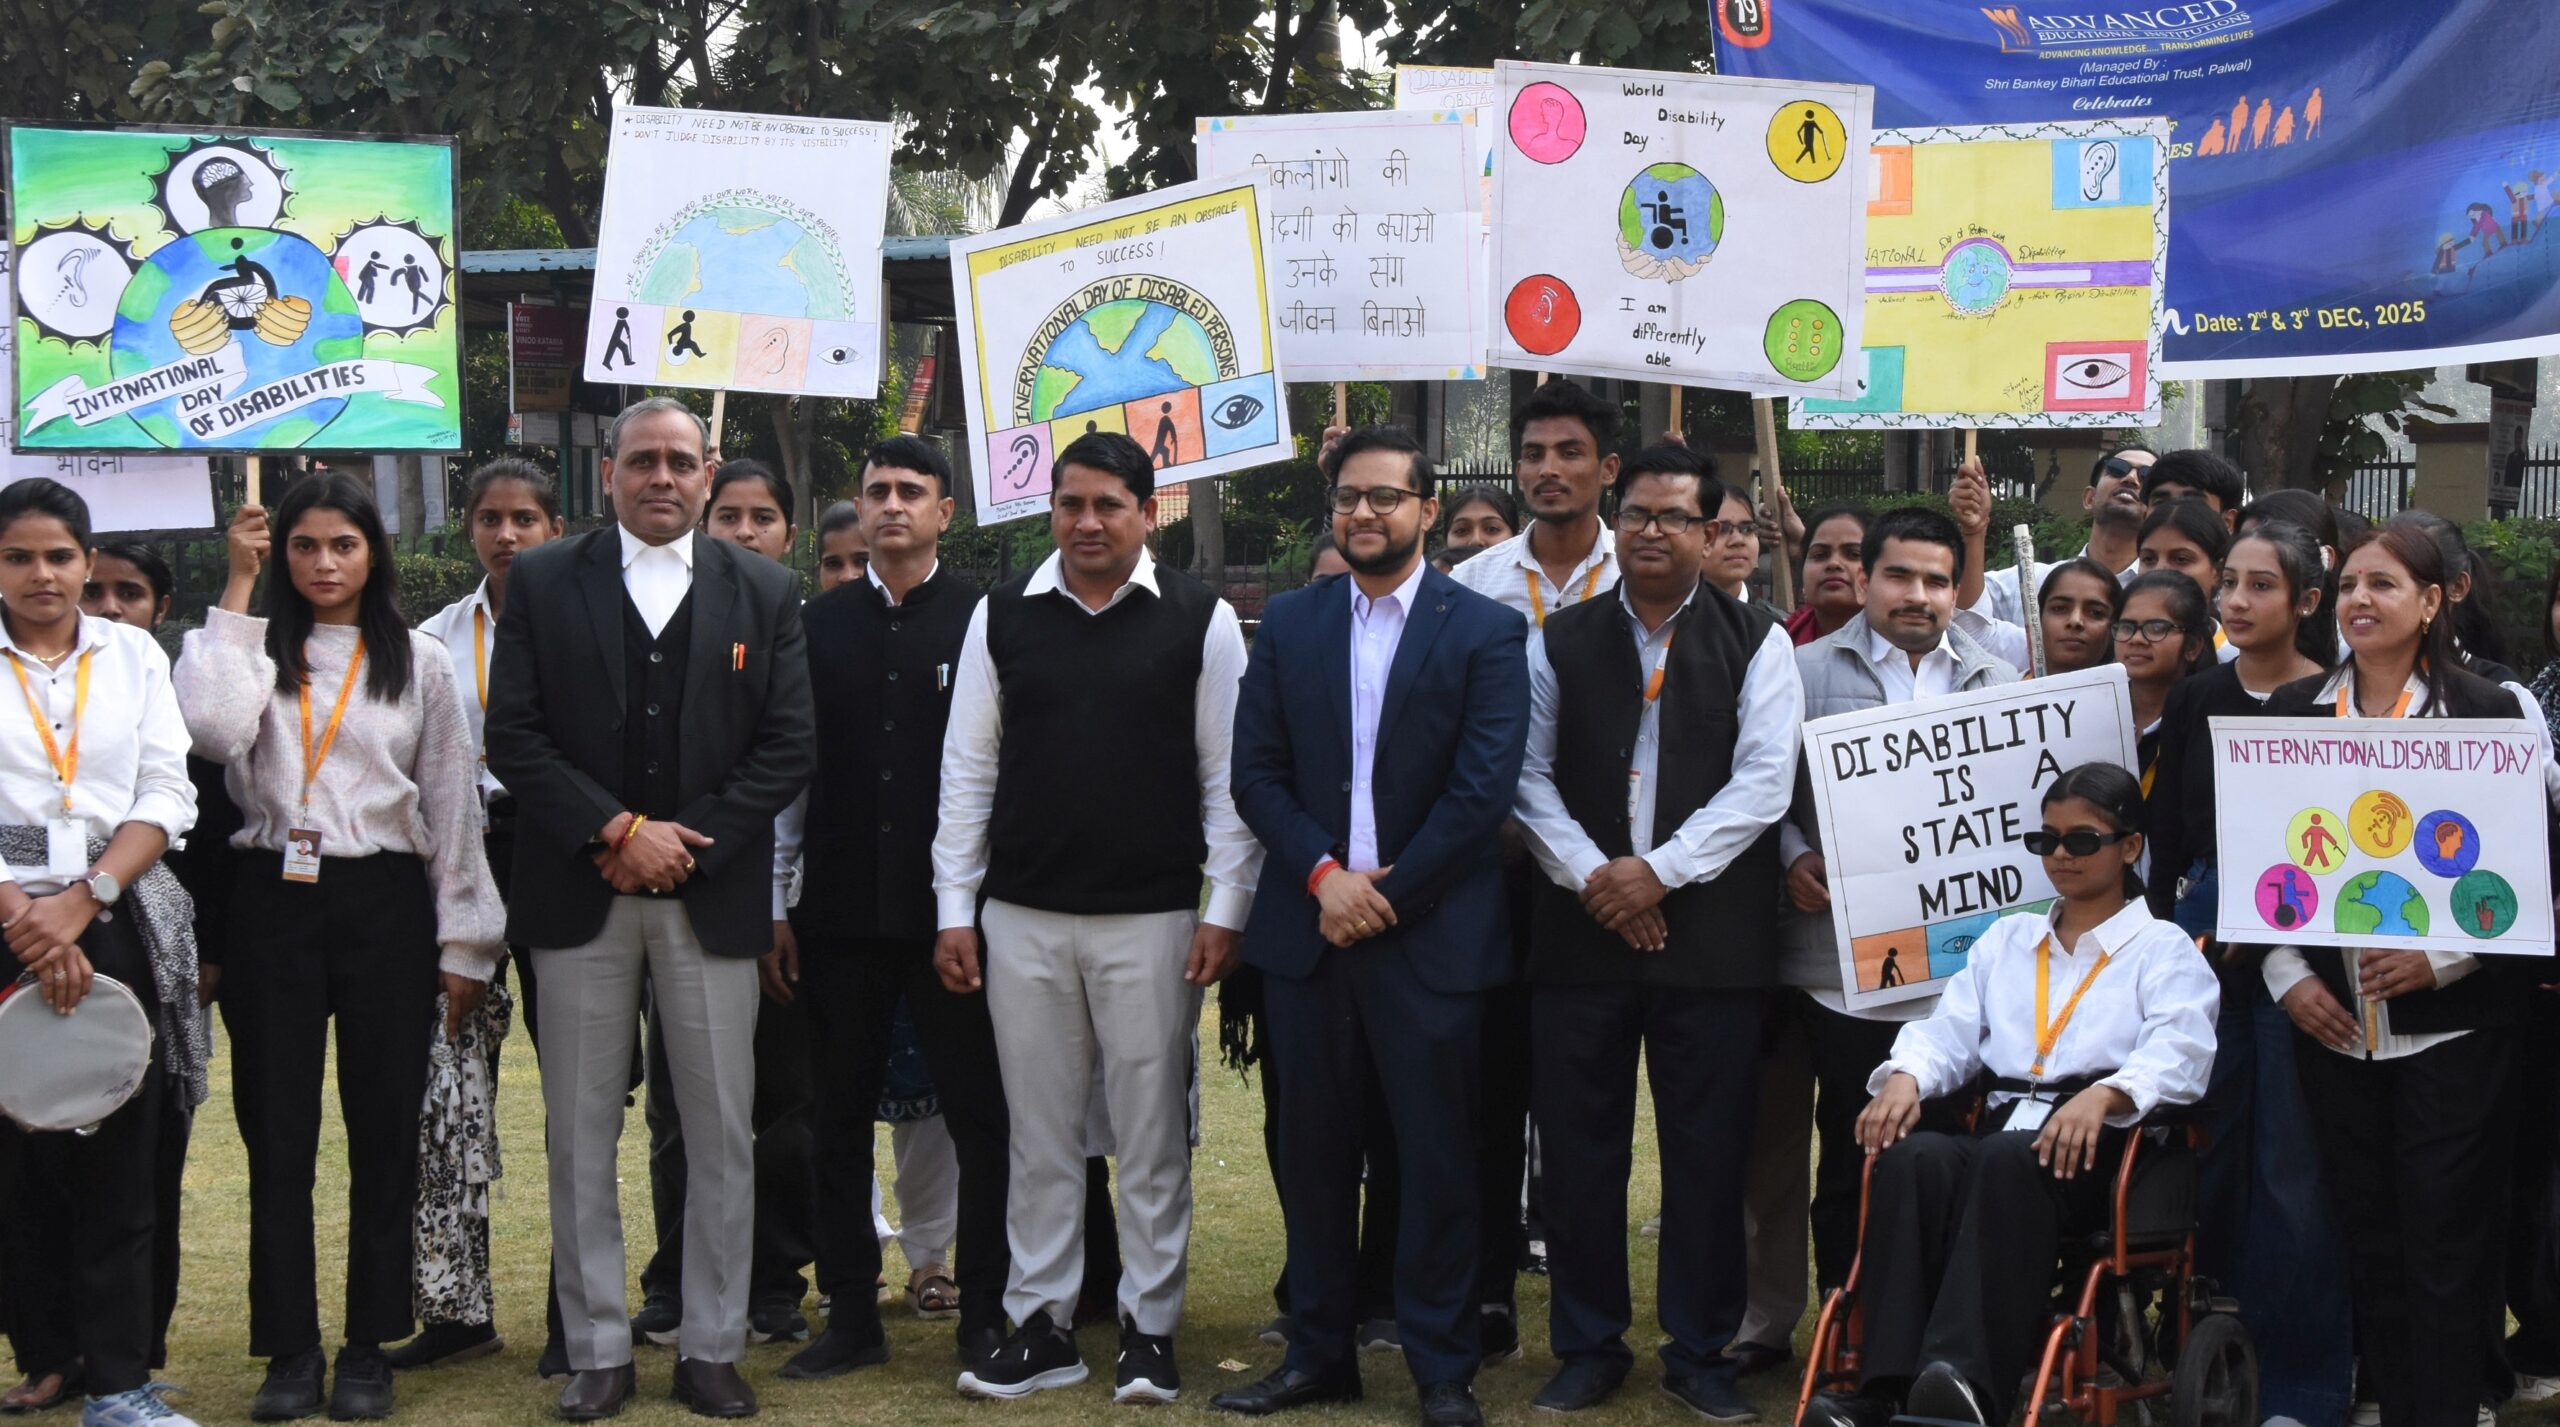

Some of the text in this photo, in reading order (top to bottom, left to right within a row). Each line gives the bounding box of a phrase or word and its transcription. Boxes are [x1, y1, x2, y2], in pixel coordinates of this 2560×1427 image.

[1735, 0, 1757, 23] 19
[2029, 0, 2239, 30] ADVANCED
[2037, 12, 2251, 41] EDUCATIONAL INSTITUTIONS
[2039, 48, 2090, 59] ADVANCING
[2230, 29, 2254, 42] LIVES
[1985, 58, 2251, 91] Shri Bankey Bihari Educational Trust, Palwal)
[2080, 60, 2140, 75] (Managed
[2143, 59, 2160, 73] By
[1623, 83, 1664, 97] World
[2072, 95, 2153, 111] Celebrates
[635, 114, 682, 125] DISABILITY
[691, 118, 725, 130] NEED
[751, 121, 762, 132] BE
[764, 122, 780, 132] AN
[821, 126, 830, 136] TO
[1658, 108, 1725, 132] Disability
[634, 130, 659, 139] DON'T
[665, 131, 698, 143] JUDGE
[702, 134, 760, 146] DISABILITY
[764, 137, 776, 146] BY
[1624, 131, 1649, 153] Day
[1382, 149, 1410, 187] की
[999, 200, 1239, 270] DISABILITY NEED NOT BE AN OBSTACLE
[1332, 205, 1359, 243] को
[1377, 207, 1437, 244] बचाओ
[1059, 259, 1075, 274] TO
[1285, 249, 1406, 288] उनके संग
[1279, 296, 1426, 338] जीवन बिताओ
[1619, 297, 1667, 314] I am
[2195, 313, 2243, 333] Date:
[2271, 312, 2287, 331] &
[2318, 306, 2370, 330] DEC,
[2375, 301, 2426, 326] 2025
[1082, 283, 1110, 309] DAY
[1111, 278, 1133, 300] OF
[1137, 277, 1209, 322] DISABLED
[1204, 314, 1237, 378] PERSONS
[1632, 322, 1706, 355] differently
[1645, 351, 1671, 367] able
[67, 356, 225, 421] INTRNATIONAL
[181, 383, 223, 413] DAY
[189, 364, 366, 437] OF DISABILITIES
[2490, 740, 2535, 775] DAY
[1933, 748, 2064, 807] IS A
[1902, 802, 2023, 864] STATE
[1918, 864, 2023, 921] MIND
